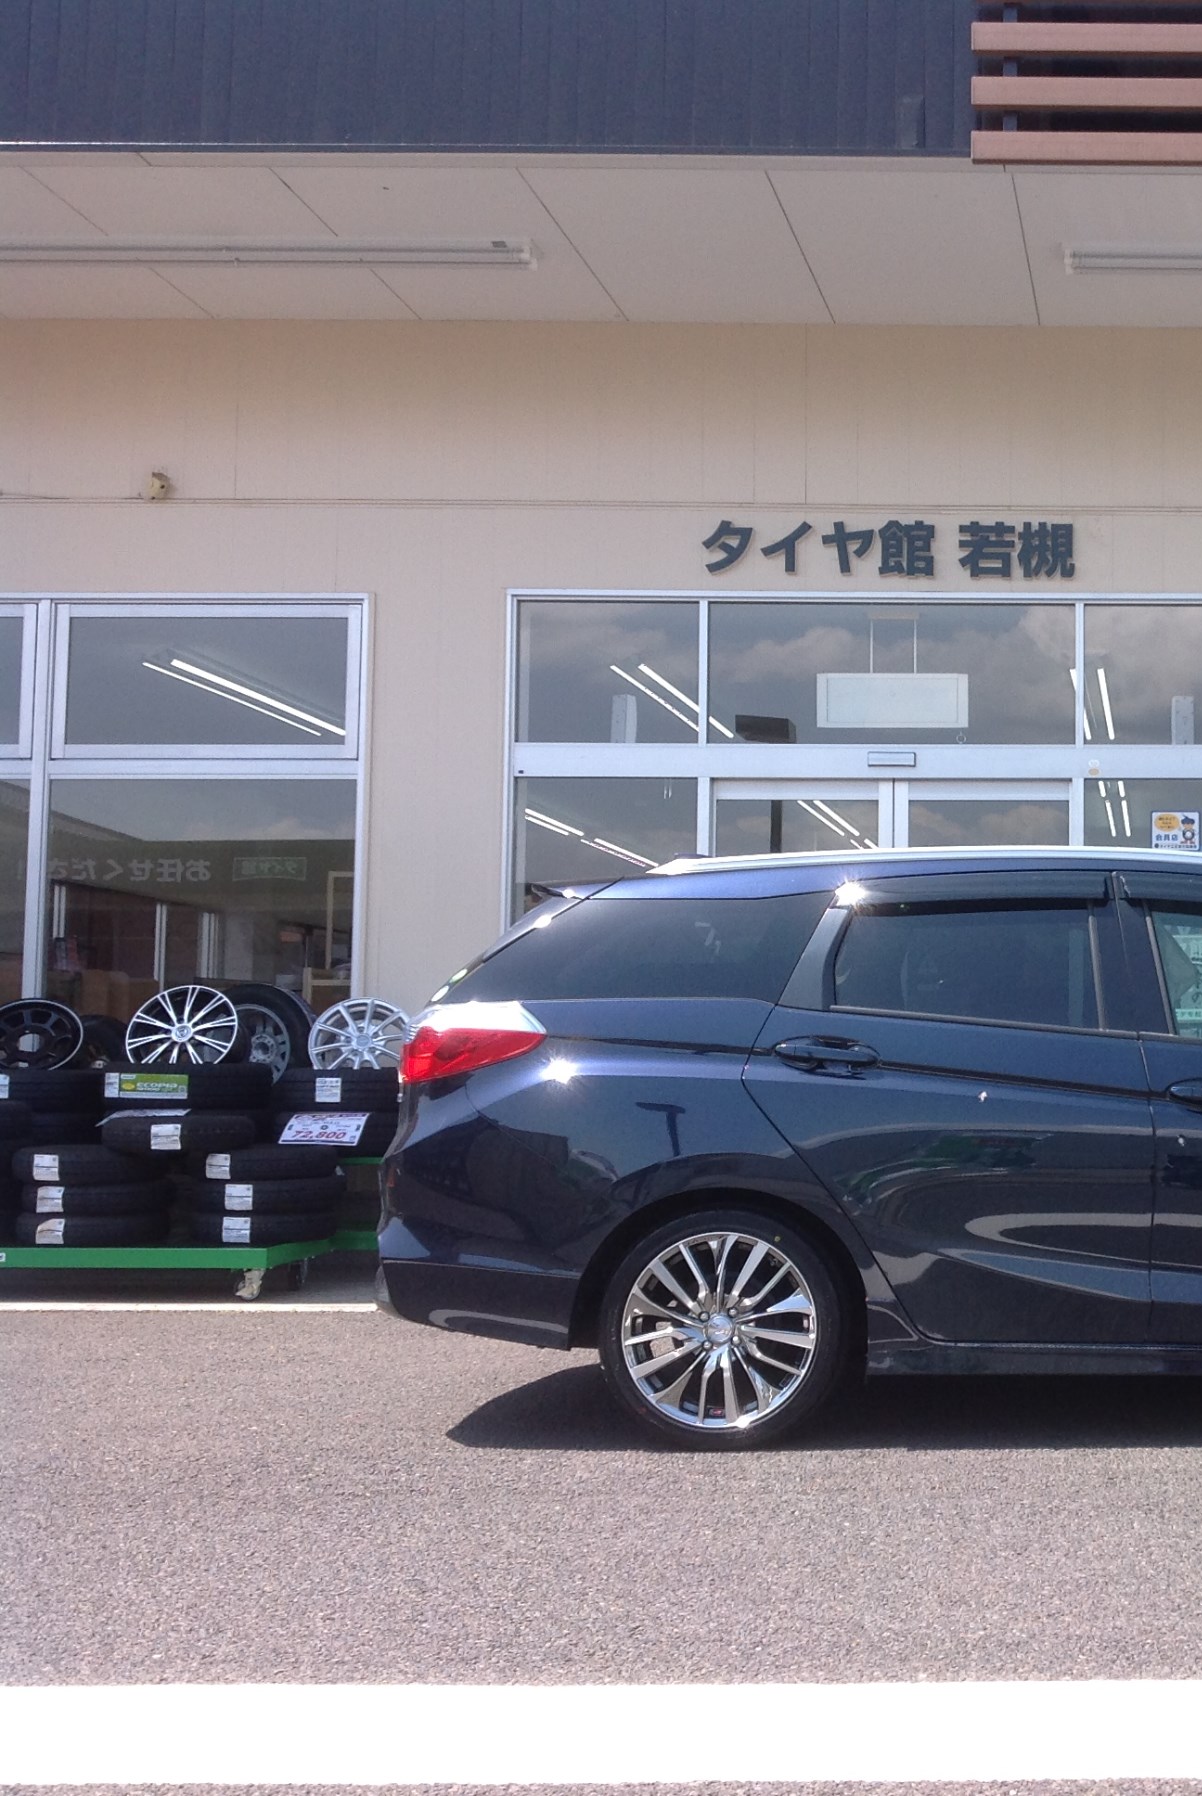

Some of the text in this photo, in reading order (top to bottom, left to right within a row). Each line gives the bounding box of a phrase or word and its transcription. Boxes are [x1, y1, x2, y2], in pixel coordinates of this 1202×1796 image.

[702, 519, 1076, 578] タイヤ館 若槻
[292, 1130, 346, 1140] 72,800
